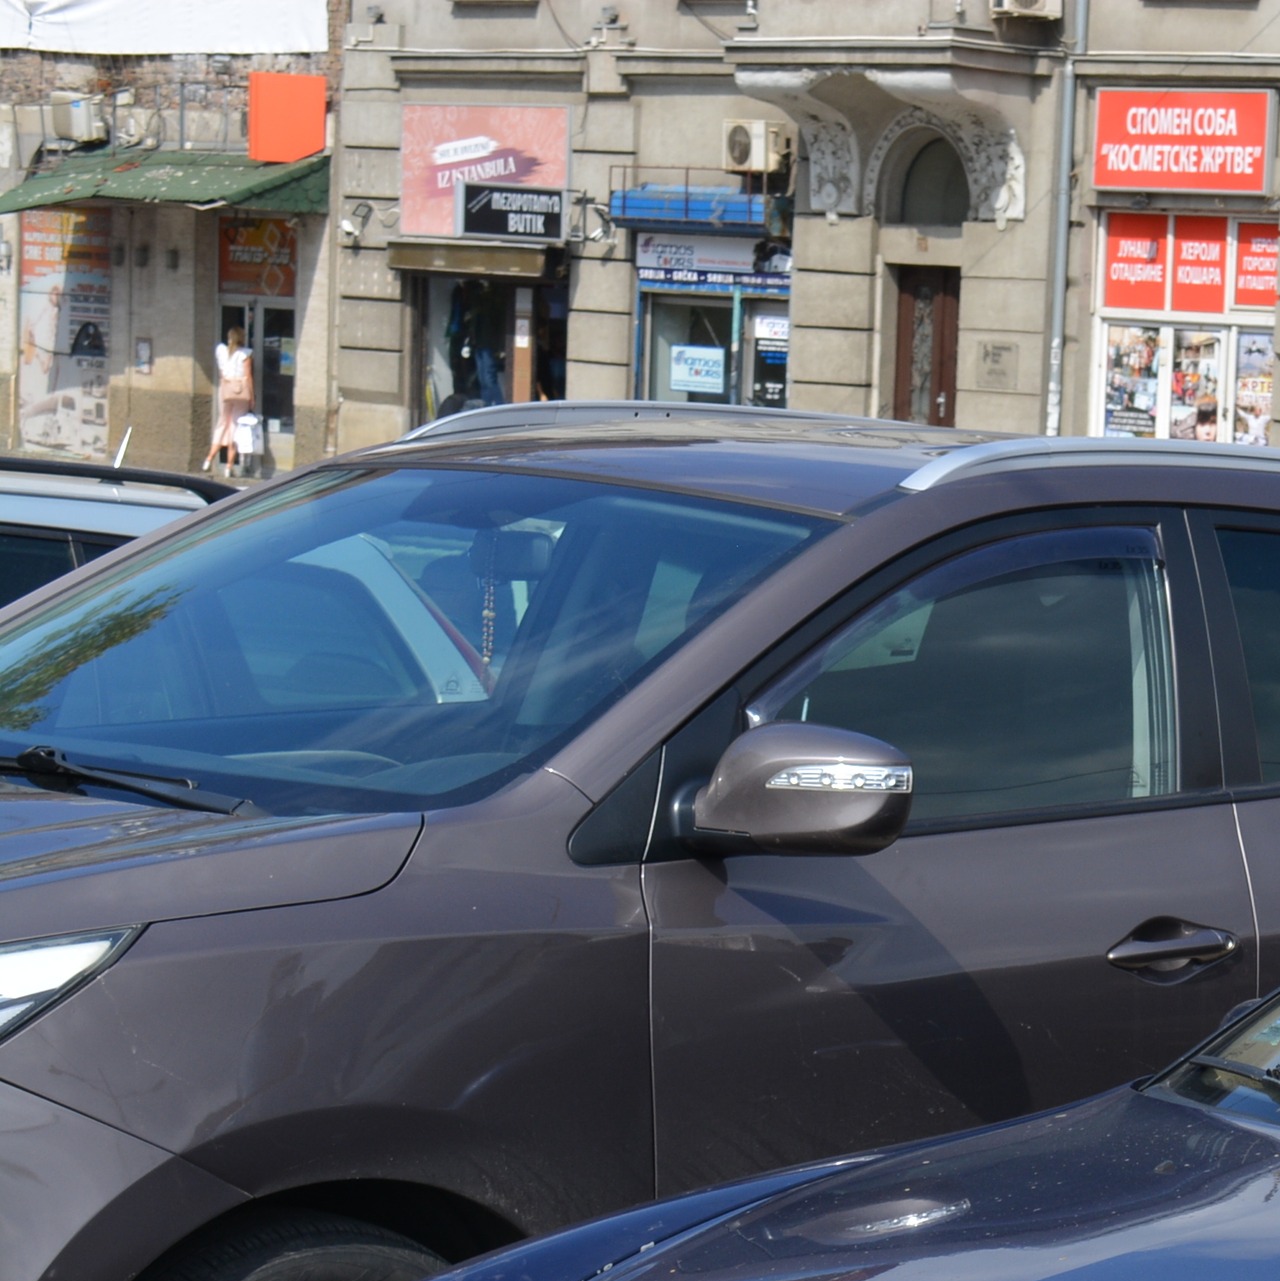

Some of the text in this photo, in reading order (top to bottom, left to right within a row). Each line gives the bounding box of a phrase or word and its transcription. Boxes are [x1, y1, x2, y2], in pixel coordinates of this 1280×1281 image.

[1126, 107, 1237, 136] СПОМЕН СОБА
[508, 213, 544, 233] BUTIK
[1181, 242, 1220, 261] ХЕРОЈИ
[1177, 266, 1221, 285] КОШАРА
